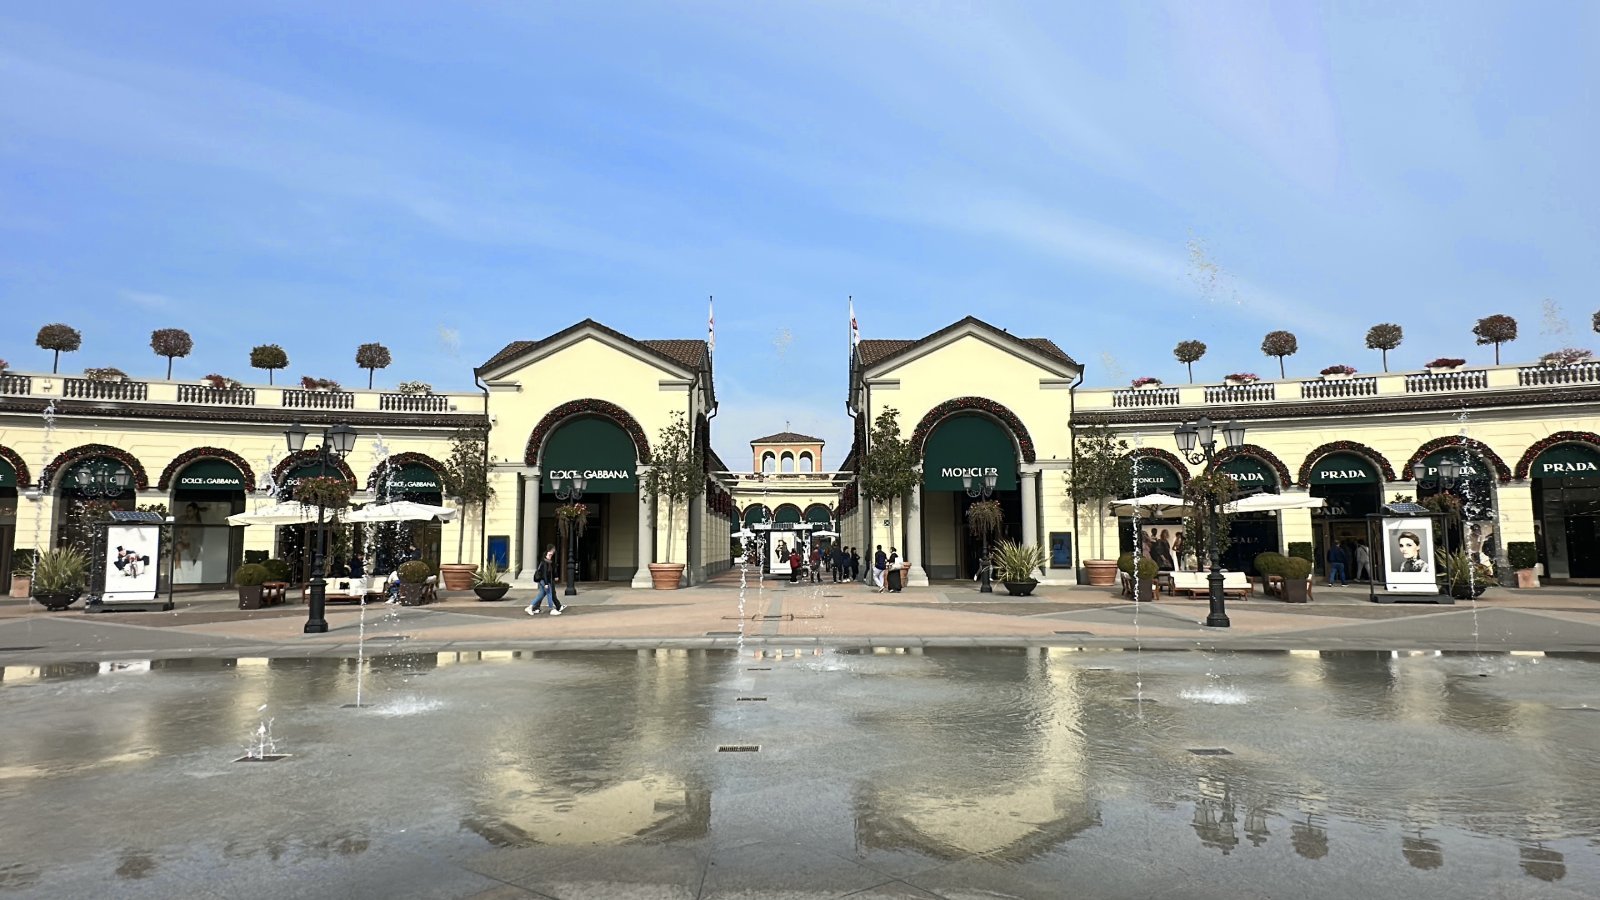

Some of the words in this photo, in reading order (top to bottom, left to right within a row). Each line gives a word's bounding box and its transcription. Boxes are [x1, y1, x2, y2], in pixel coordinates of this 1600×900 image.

[1428, 466, 1477, 476] PDA
[1542, 461, 1598, 472] PRADA
[583, 470, 629, 479] GABBANA
[1320, 469, 1366, 479] PRADA
